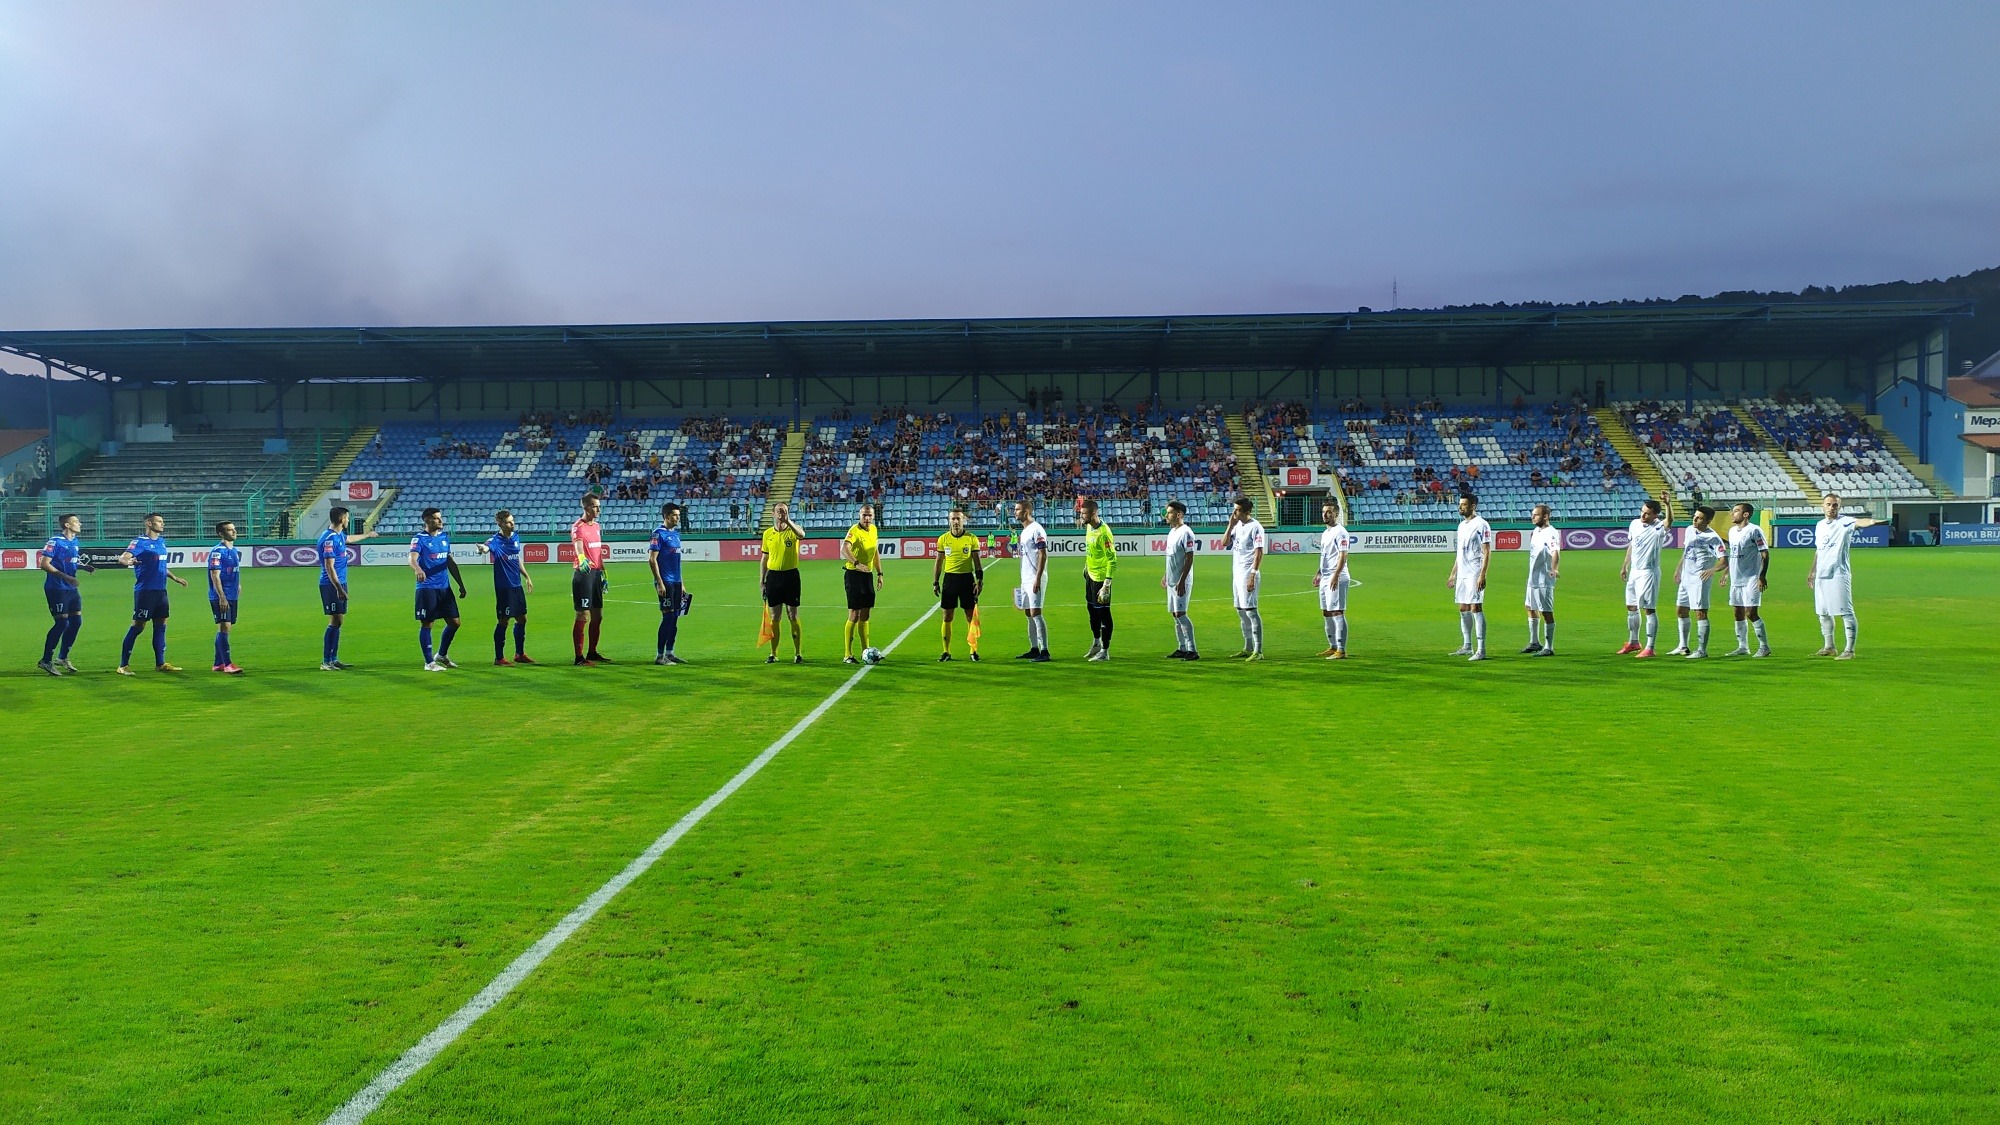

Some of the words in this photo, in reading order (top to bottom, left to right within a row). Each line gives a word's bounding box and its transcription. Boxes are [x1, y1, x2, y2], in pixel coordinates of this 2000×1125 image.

[1945, 530, 1977, 539] ŠIROKI
[1269, 538, 1301, 552] leda
[1364, 536, 1374, 545] JP
[1375, 535, 1448, 544] ELEKTROPRIVREDA
[56, 603, 64, 612] 17
[582, 598, 589, 608] 12
[138, 608, 148, 618] 24
